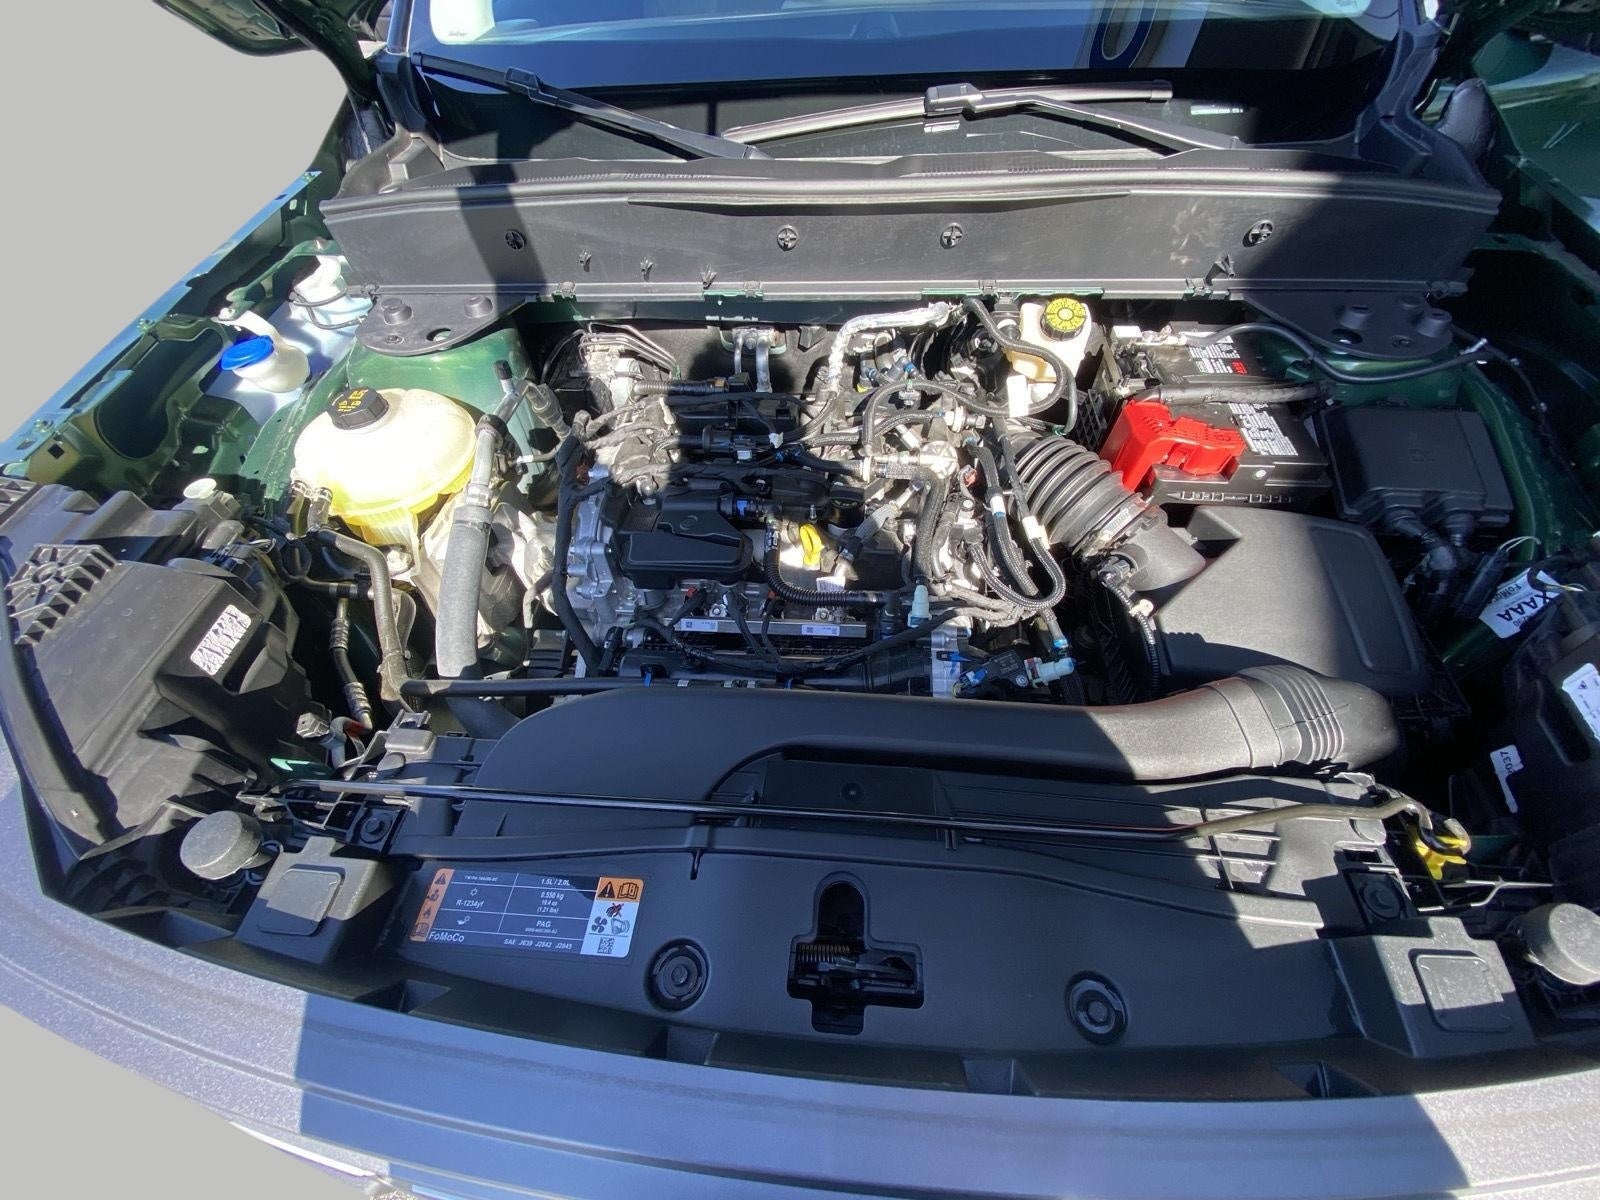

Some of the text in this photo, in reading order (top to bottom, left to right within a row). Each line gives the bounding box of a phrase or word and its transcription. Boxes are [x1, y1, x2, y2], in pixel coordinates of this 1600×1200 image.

[1496, 591, 1553, 622] XAAA
[556, 892, 565, 900] kg
[456, 899, 485, 909] R-1234yf
[536, 920, 552, 928] PAG
[428, 931, 465, 943] FoMoCo
